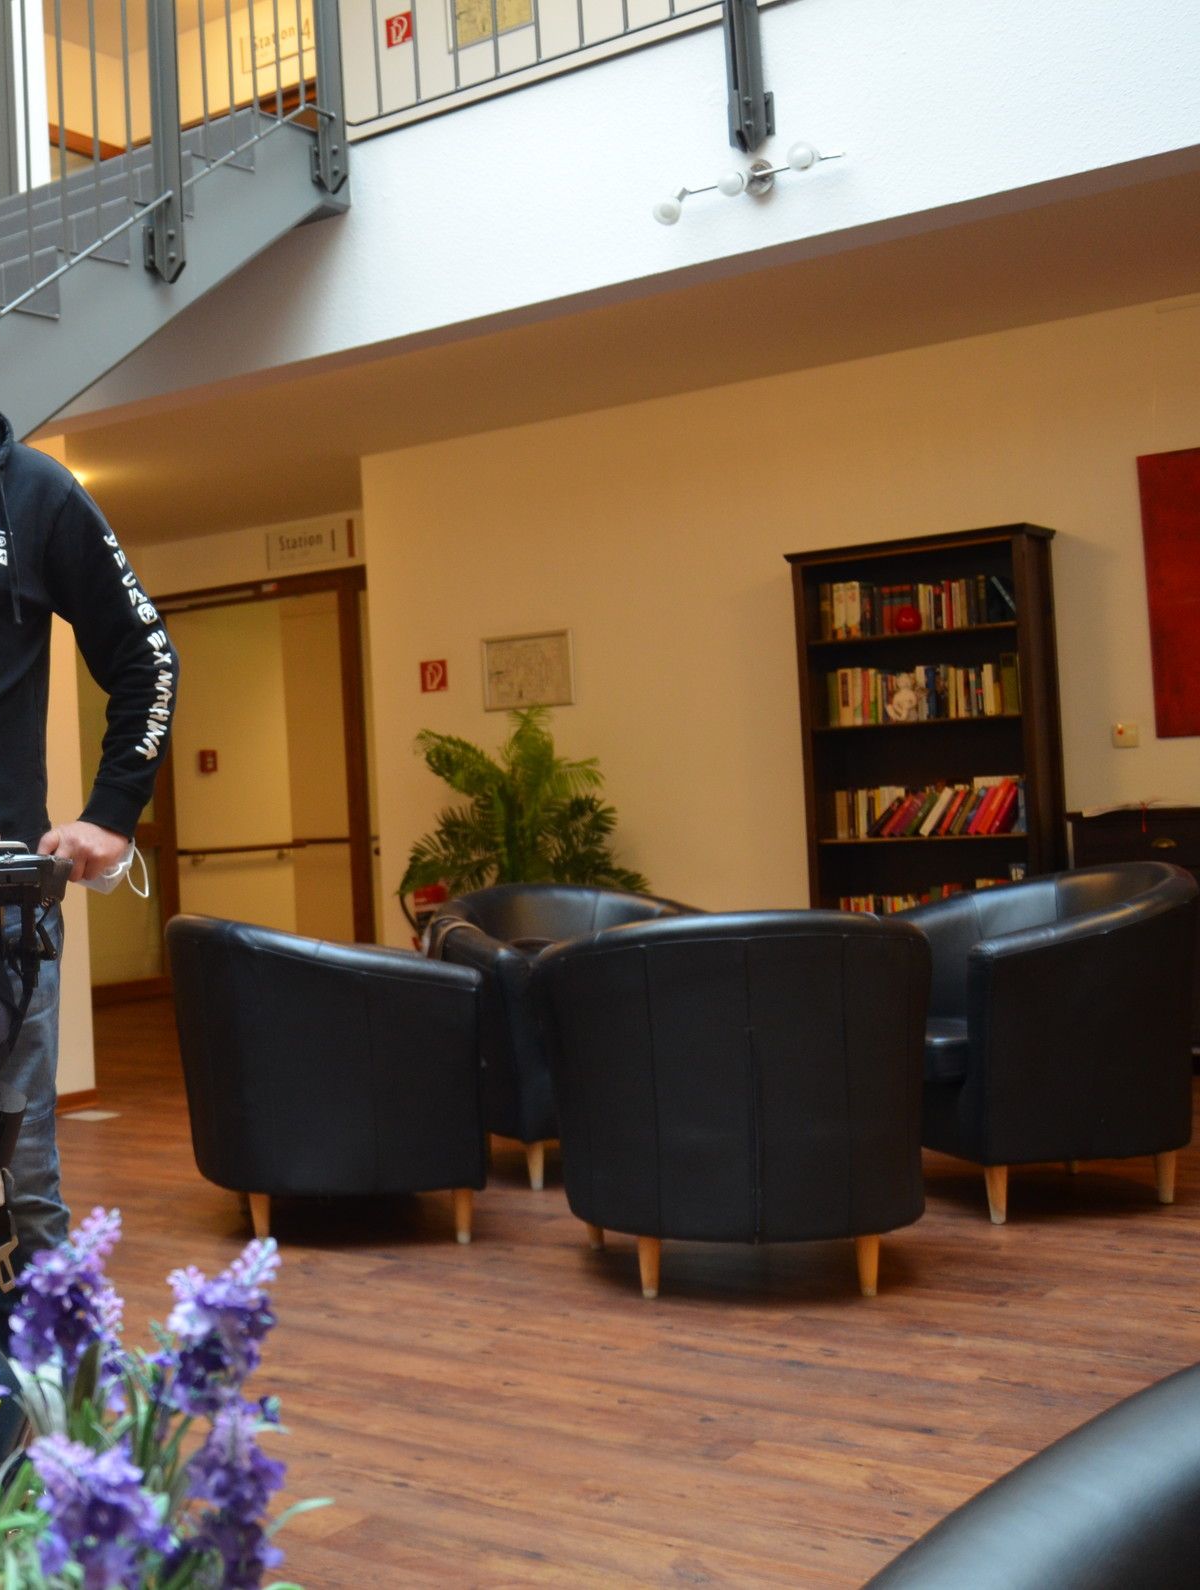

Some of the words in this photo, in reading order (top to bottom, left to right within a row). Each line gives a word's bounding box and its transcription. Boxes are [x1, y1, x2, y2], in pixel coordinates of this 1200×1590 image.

[301, 18, 311, 39] 4
[279, 534, 323, 551] Station
[146, 629, 172, 666] EX
